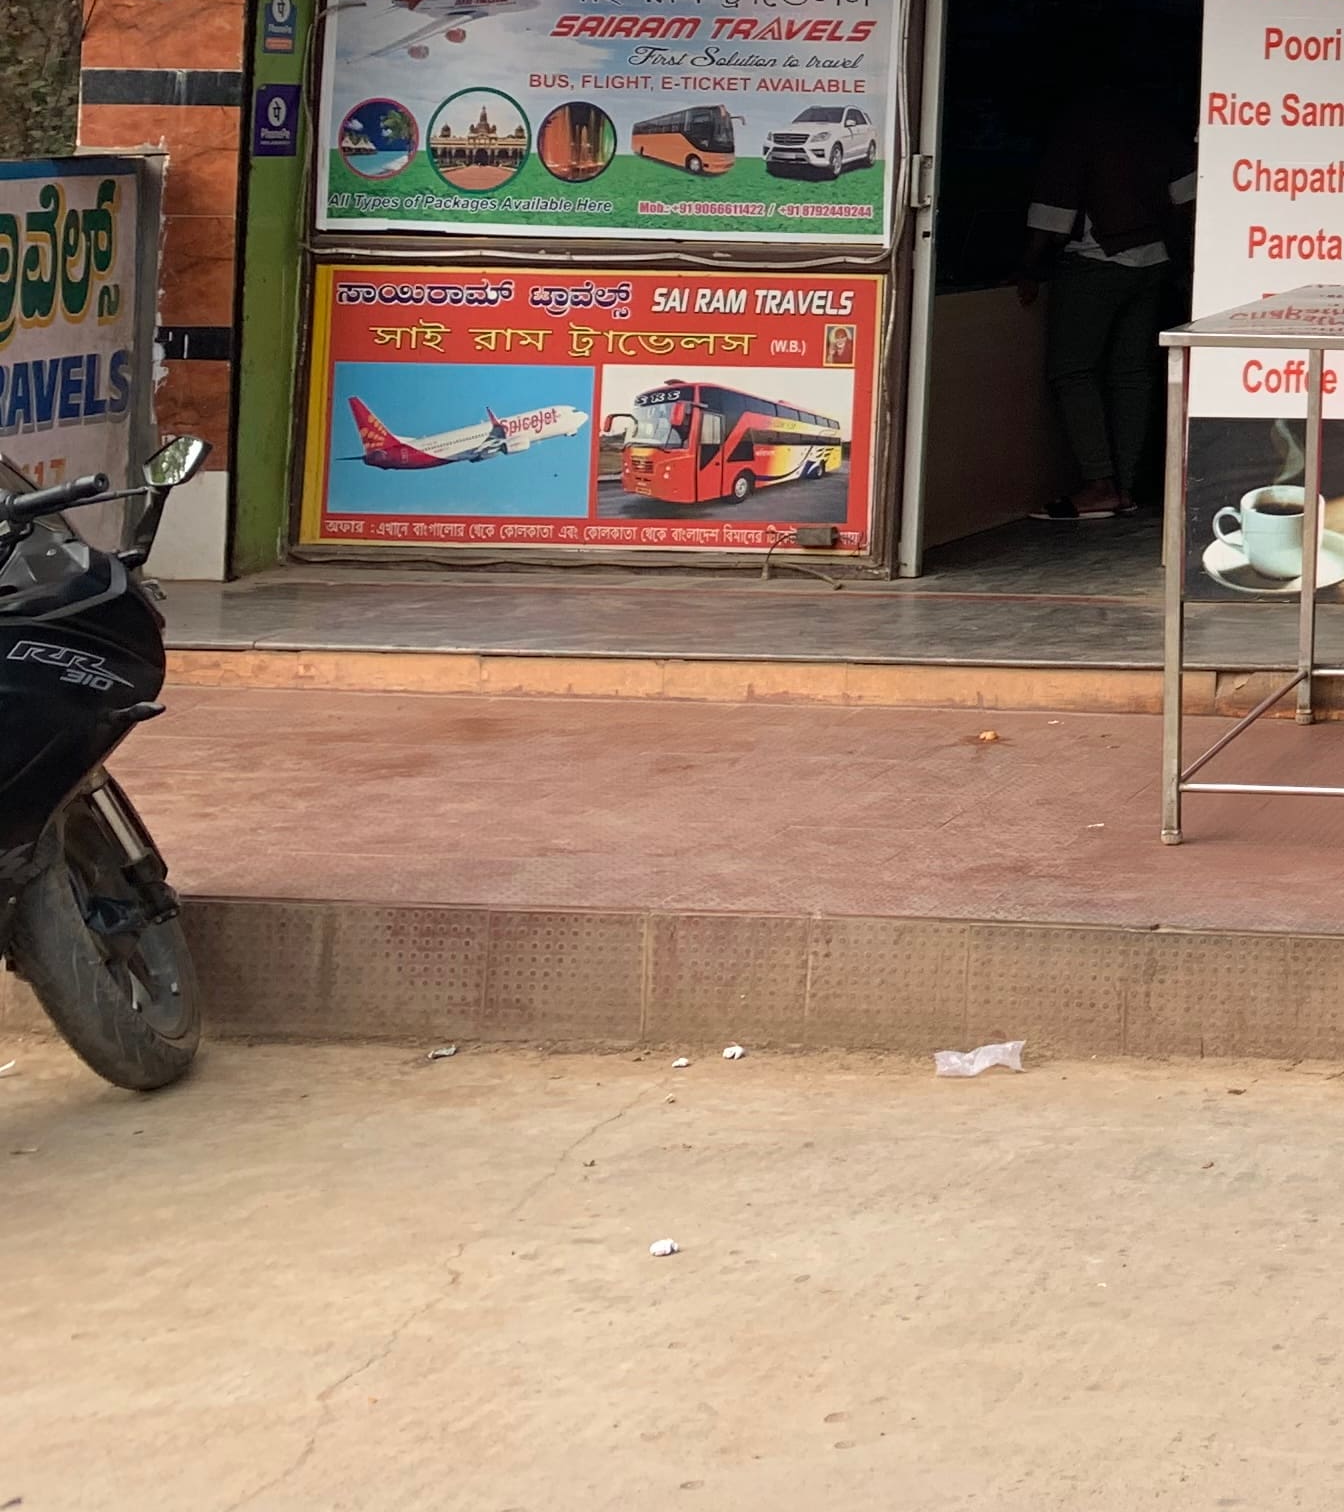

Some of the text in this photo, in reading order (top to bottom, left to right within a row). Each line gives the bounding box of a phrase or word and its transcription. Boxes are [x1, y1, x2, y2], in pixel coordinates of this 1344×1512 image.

[550, 15, 878, 43] SAIRAM TRAVELS
[691, 45, 864, 69] Solution travel
[1263, 28, 1343, 62] Poori
[528, 72, 866, 94] BUS, FLIGHT, E-TICKET AVAILABLE
[1207, 92, 1272, 127] Rice
[328, 192, 612, 214] All Types Packages Available Here
[1247, 225, 1344, 262] Parota
[651, 287, 855, 316] SAI RAM TRAVELS
[369, 318, 451, 353] সাই
[468, 327, 552, 351] রাম
[60, 668, 114, 691] 310
